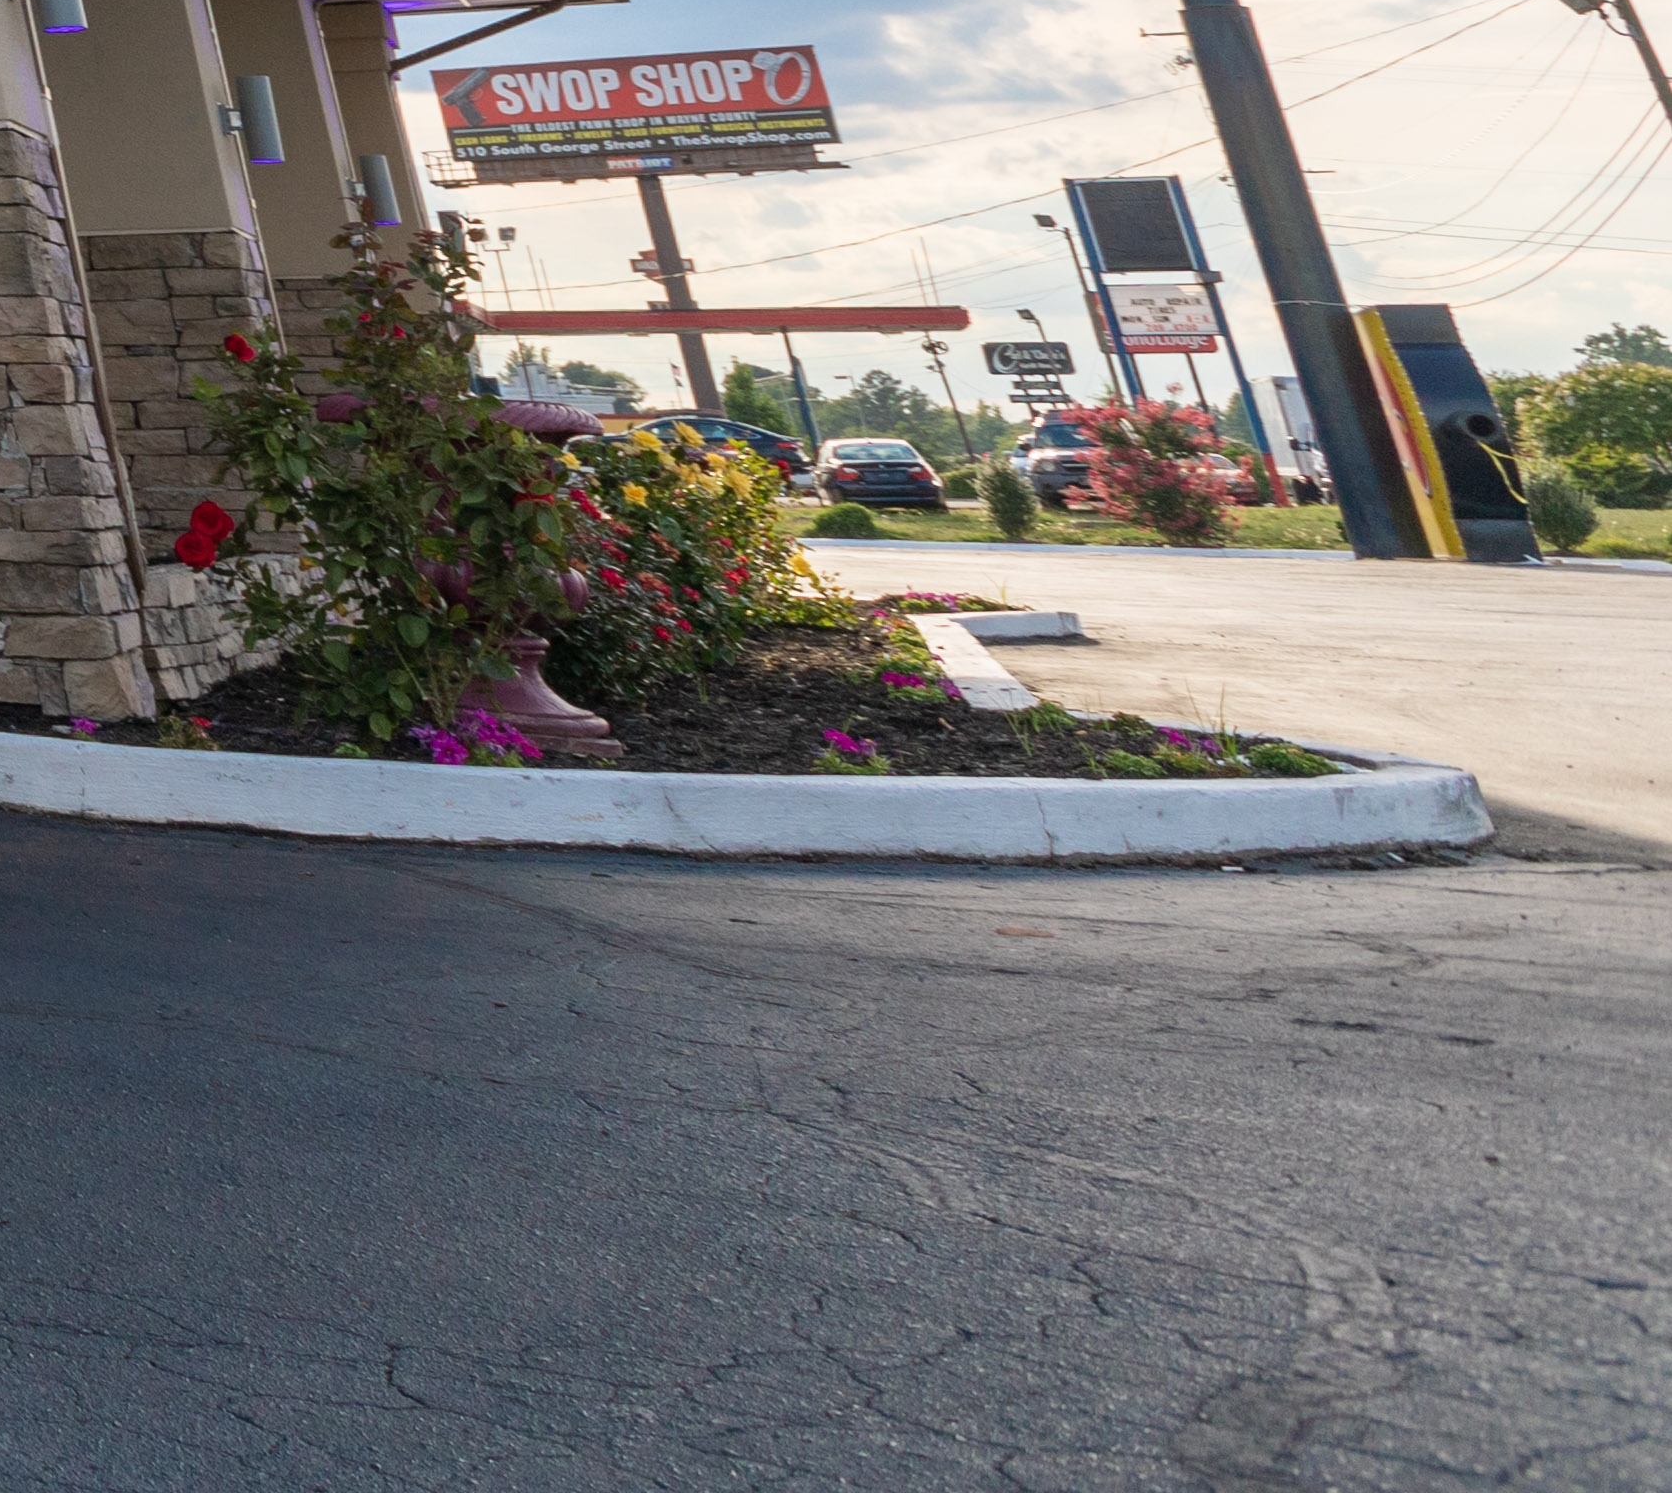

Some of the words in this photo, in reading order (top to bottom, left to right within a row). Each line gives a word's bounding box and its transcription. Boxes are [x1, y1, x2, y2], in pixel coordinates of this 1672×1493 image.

[491, 68, 620, 115] SWOP
[631, 59, 753, 107] SHOP
[510, 123, 531, 133] THE
[534, 122, 575, 132] OLDEST
[579, 120, 612, 130] PAWN
[614, 118, 645, 128] SHOP
[648, 116, 663, 126] IN
[665, 114, 706, 124] WAYNE
[709, 112, 756, 123] COUNTY
[756, 119, 827, 130] INSTRUMENTS
[456, 148, 486, 159] 510
[490, 145, 535, 156] South
[540, 143, 599, 155] George
[603, 139, 652, 151] Street
[672, 131, 831, 146] TheSwopShop.com
[608, 158, 673, 169] PATRIOT
